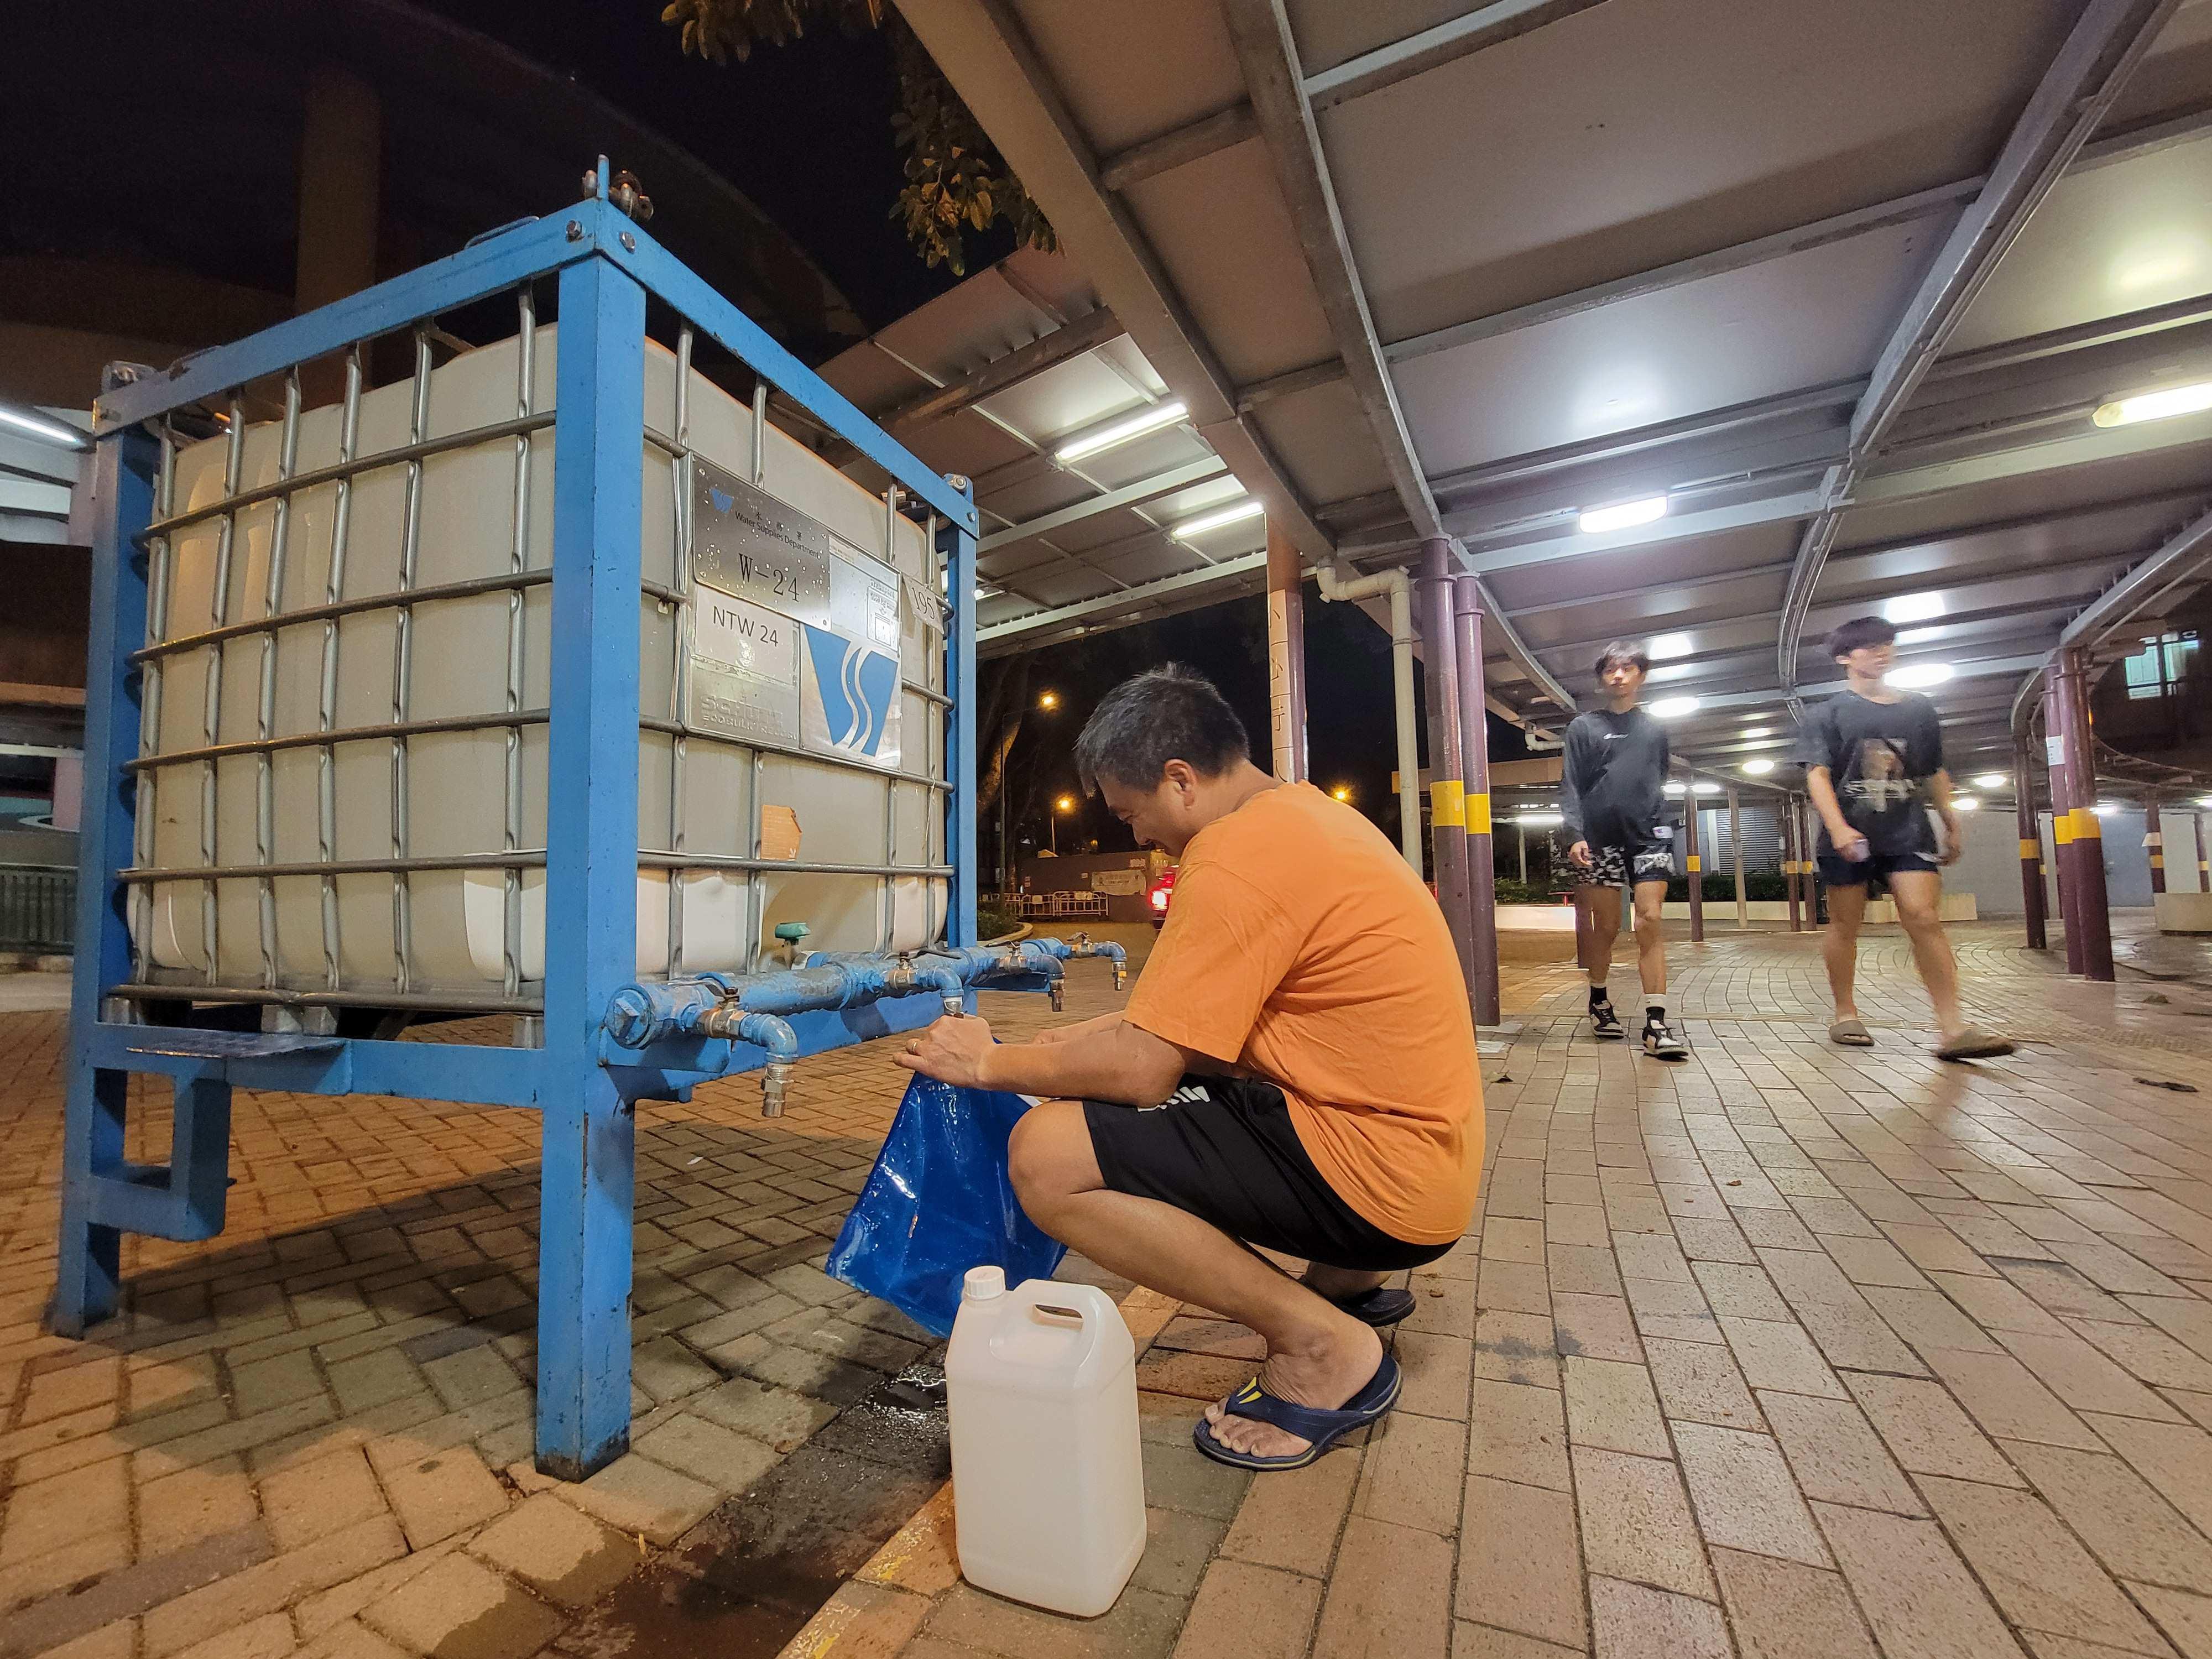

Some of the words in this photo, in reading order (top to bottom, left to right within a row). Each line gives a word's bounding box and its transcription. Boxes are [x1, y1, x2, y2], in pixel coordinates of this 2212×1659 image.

[735, 510, 755, 528] Water
[757, 522, 783, 541] Supplies
[784, 535, 818, 558] Department
[738, 552, 799, 602] W-24
[912, 587, 935, 620] 195
[713, 606, 755, 637] NTW
[760, 625, 779, 646] 24
